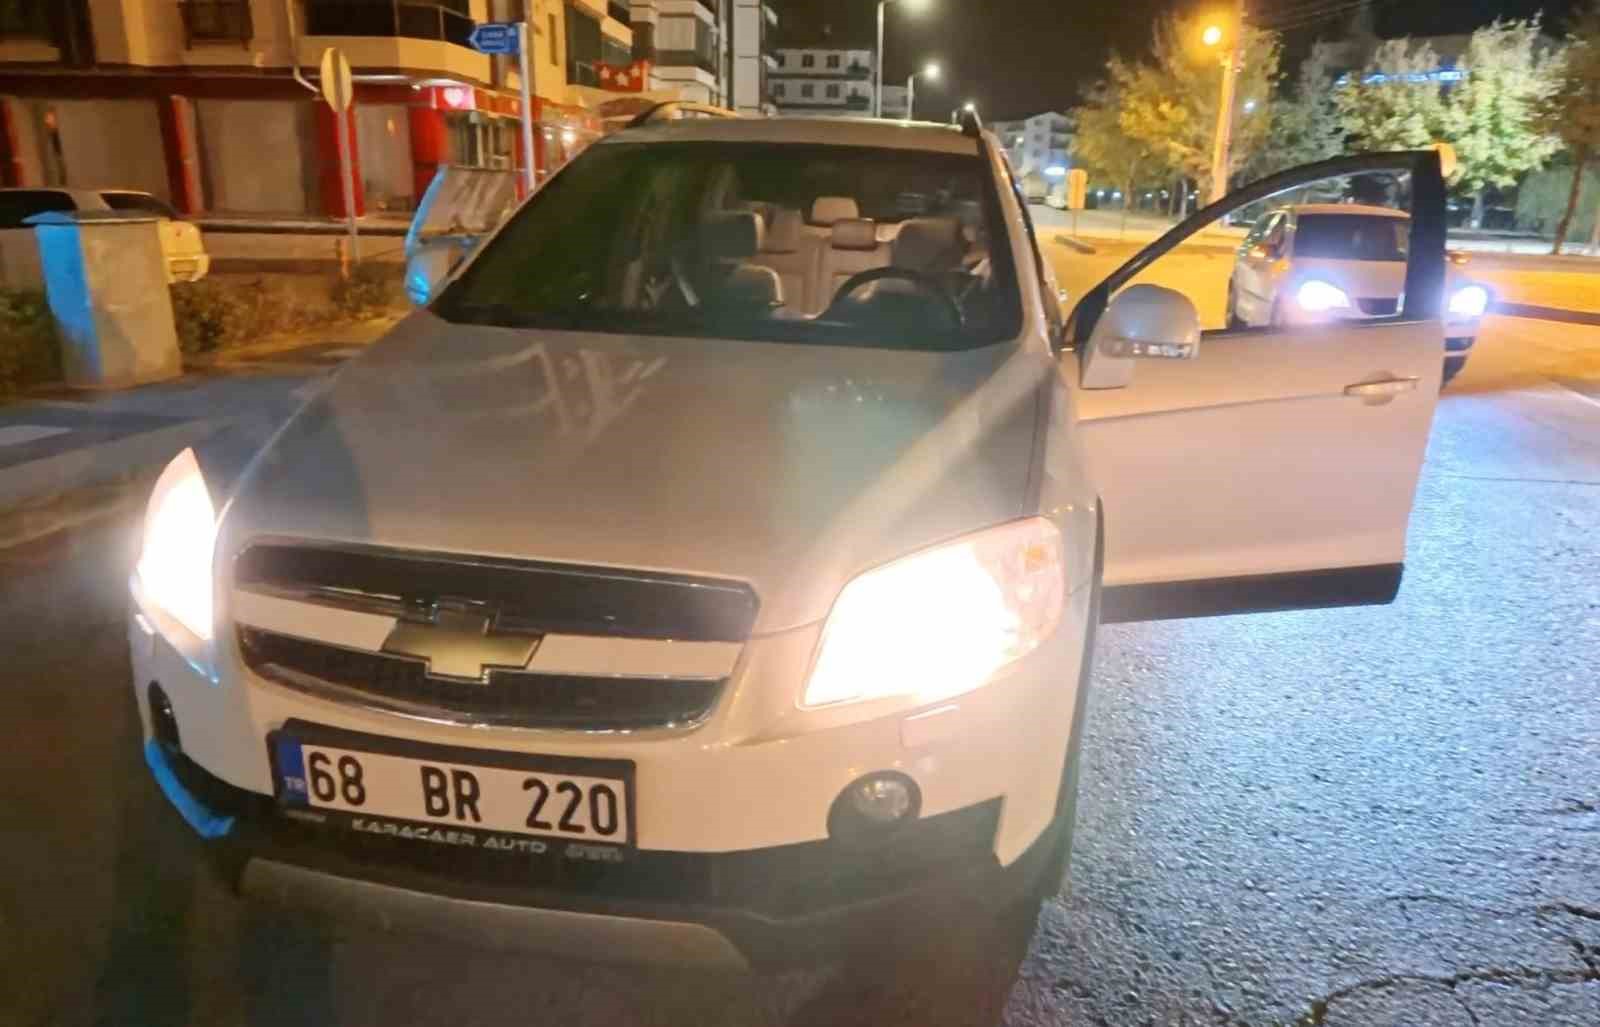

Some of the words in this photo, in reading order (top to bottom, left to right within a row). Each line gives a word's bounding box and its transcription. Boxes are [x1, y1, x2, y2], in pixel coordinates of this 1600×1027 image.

[284, 775, 305, 792] TR
[308, 751, 366, 807] 68
[420, 765, 481, 823] BR
[522, 777, 618, 836] 220
[483, 836, 547, 854] AUTO
